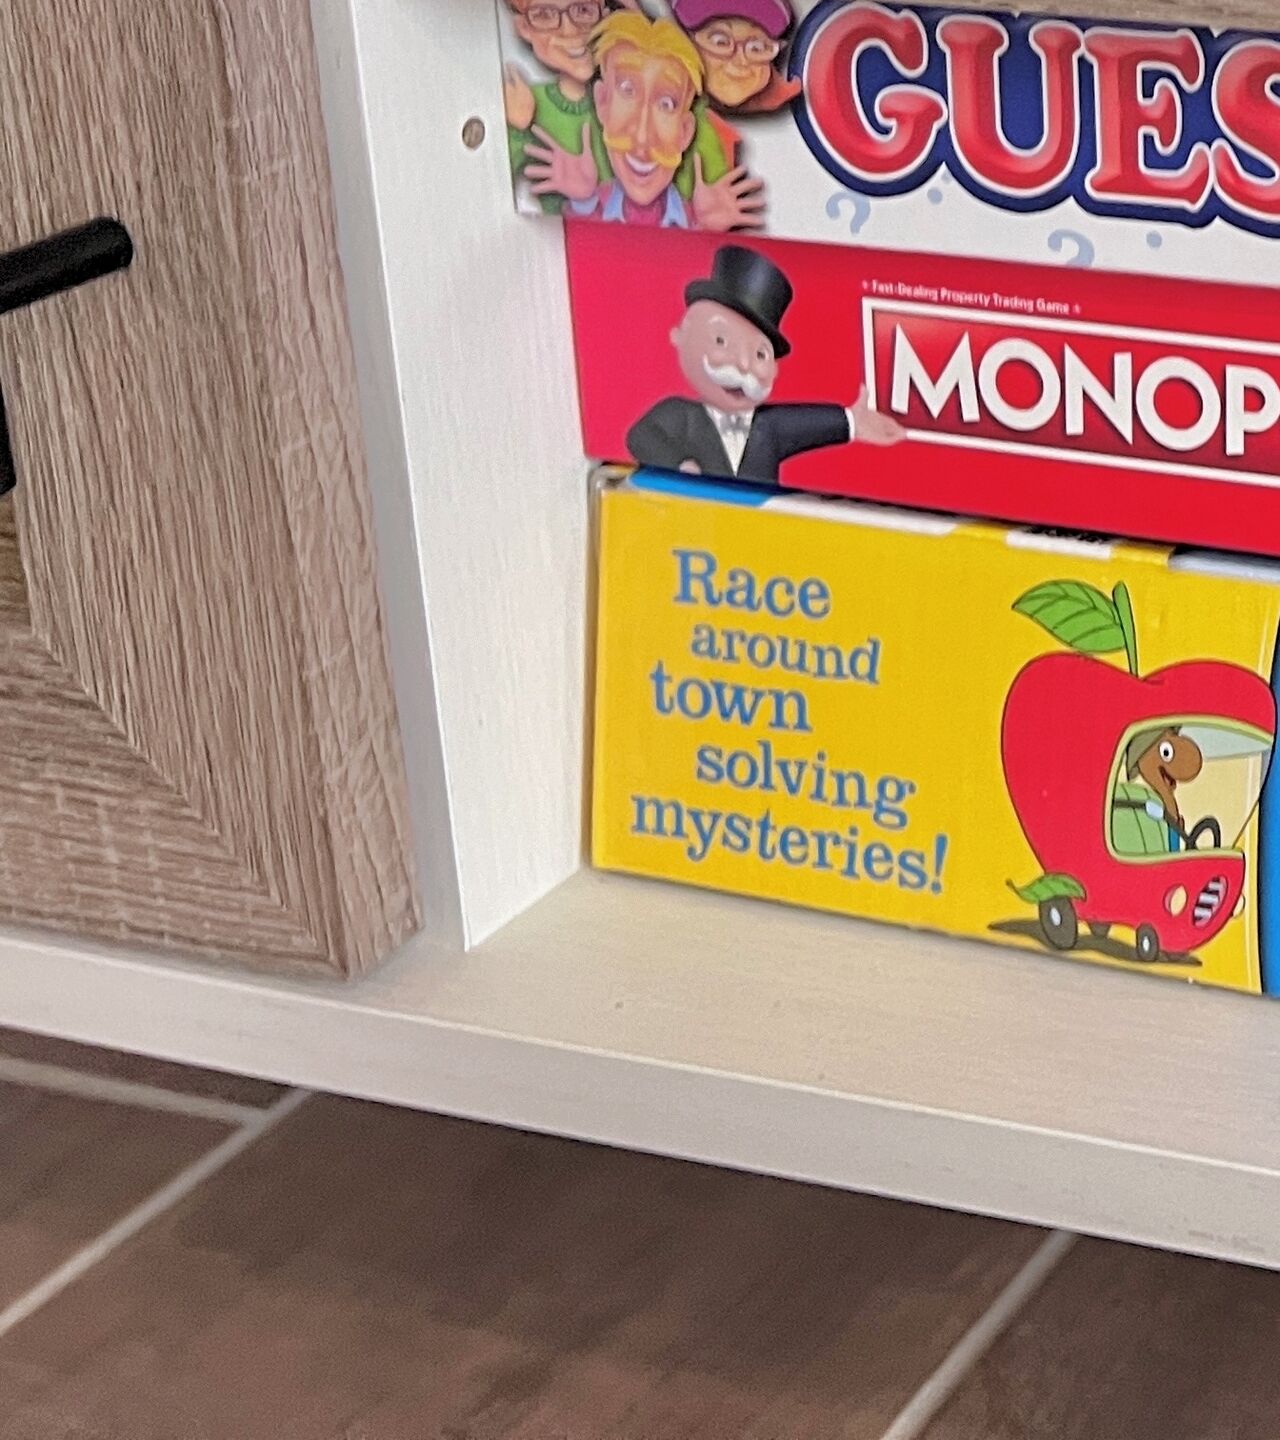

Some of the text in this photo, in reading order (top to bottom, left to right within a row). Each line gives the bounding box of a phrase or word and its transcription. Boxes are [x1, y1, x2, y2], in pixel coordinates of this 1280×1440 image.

[940, 286, 991, 307] Property
[992, 291, 1035, 311] Trading
[1036, 297, 1070, 315] Game
[671, 547, 832, 619] Race
[690, 623, 882, 685] around
[651, 664, 813, 733] town
[695, 739, 917, 831] solving
[630, 792, 951, 895] mysteries!
